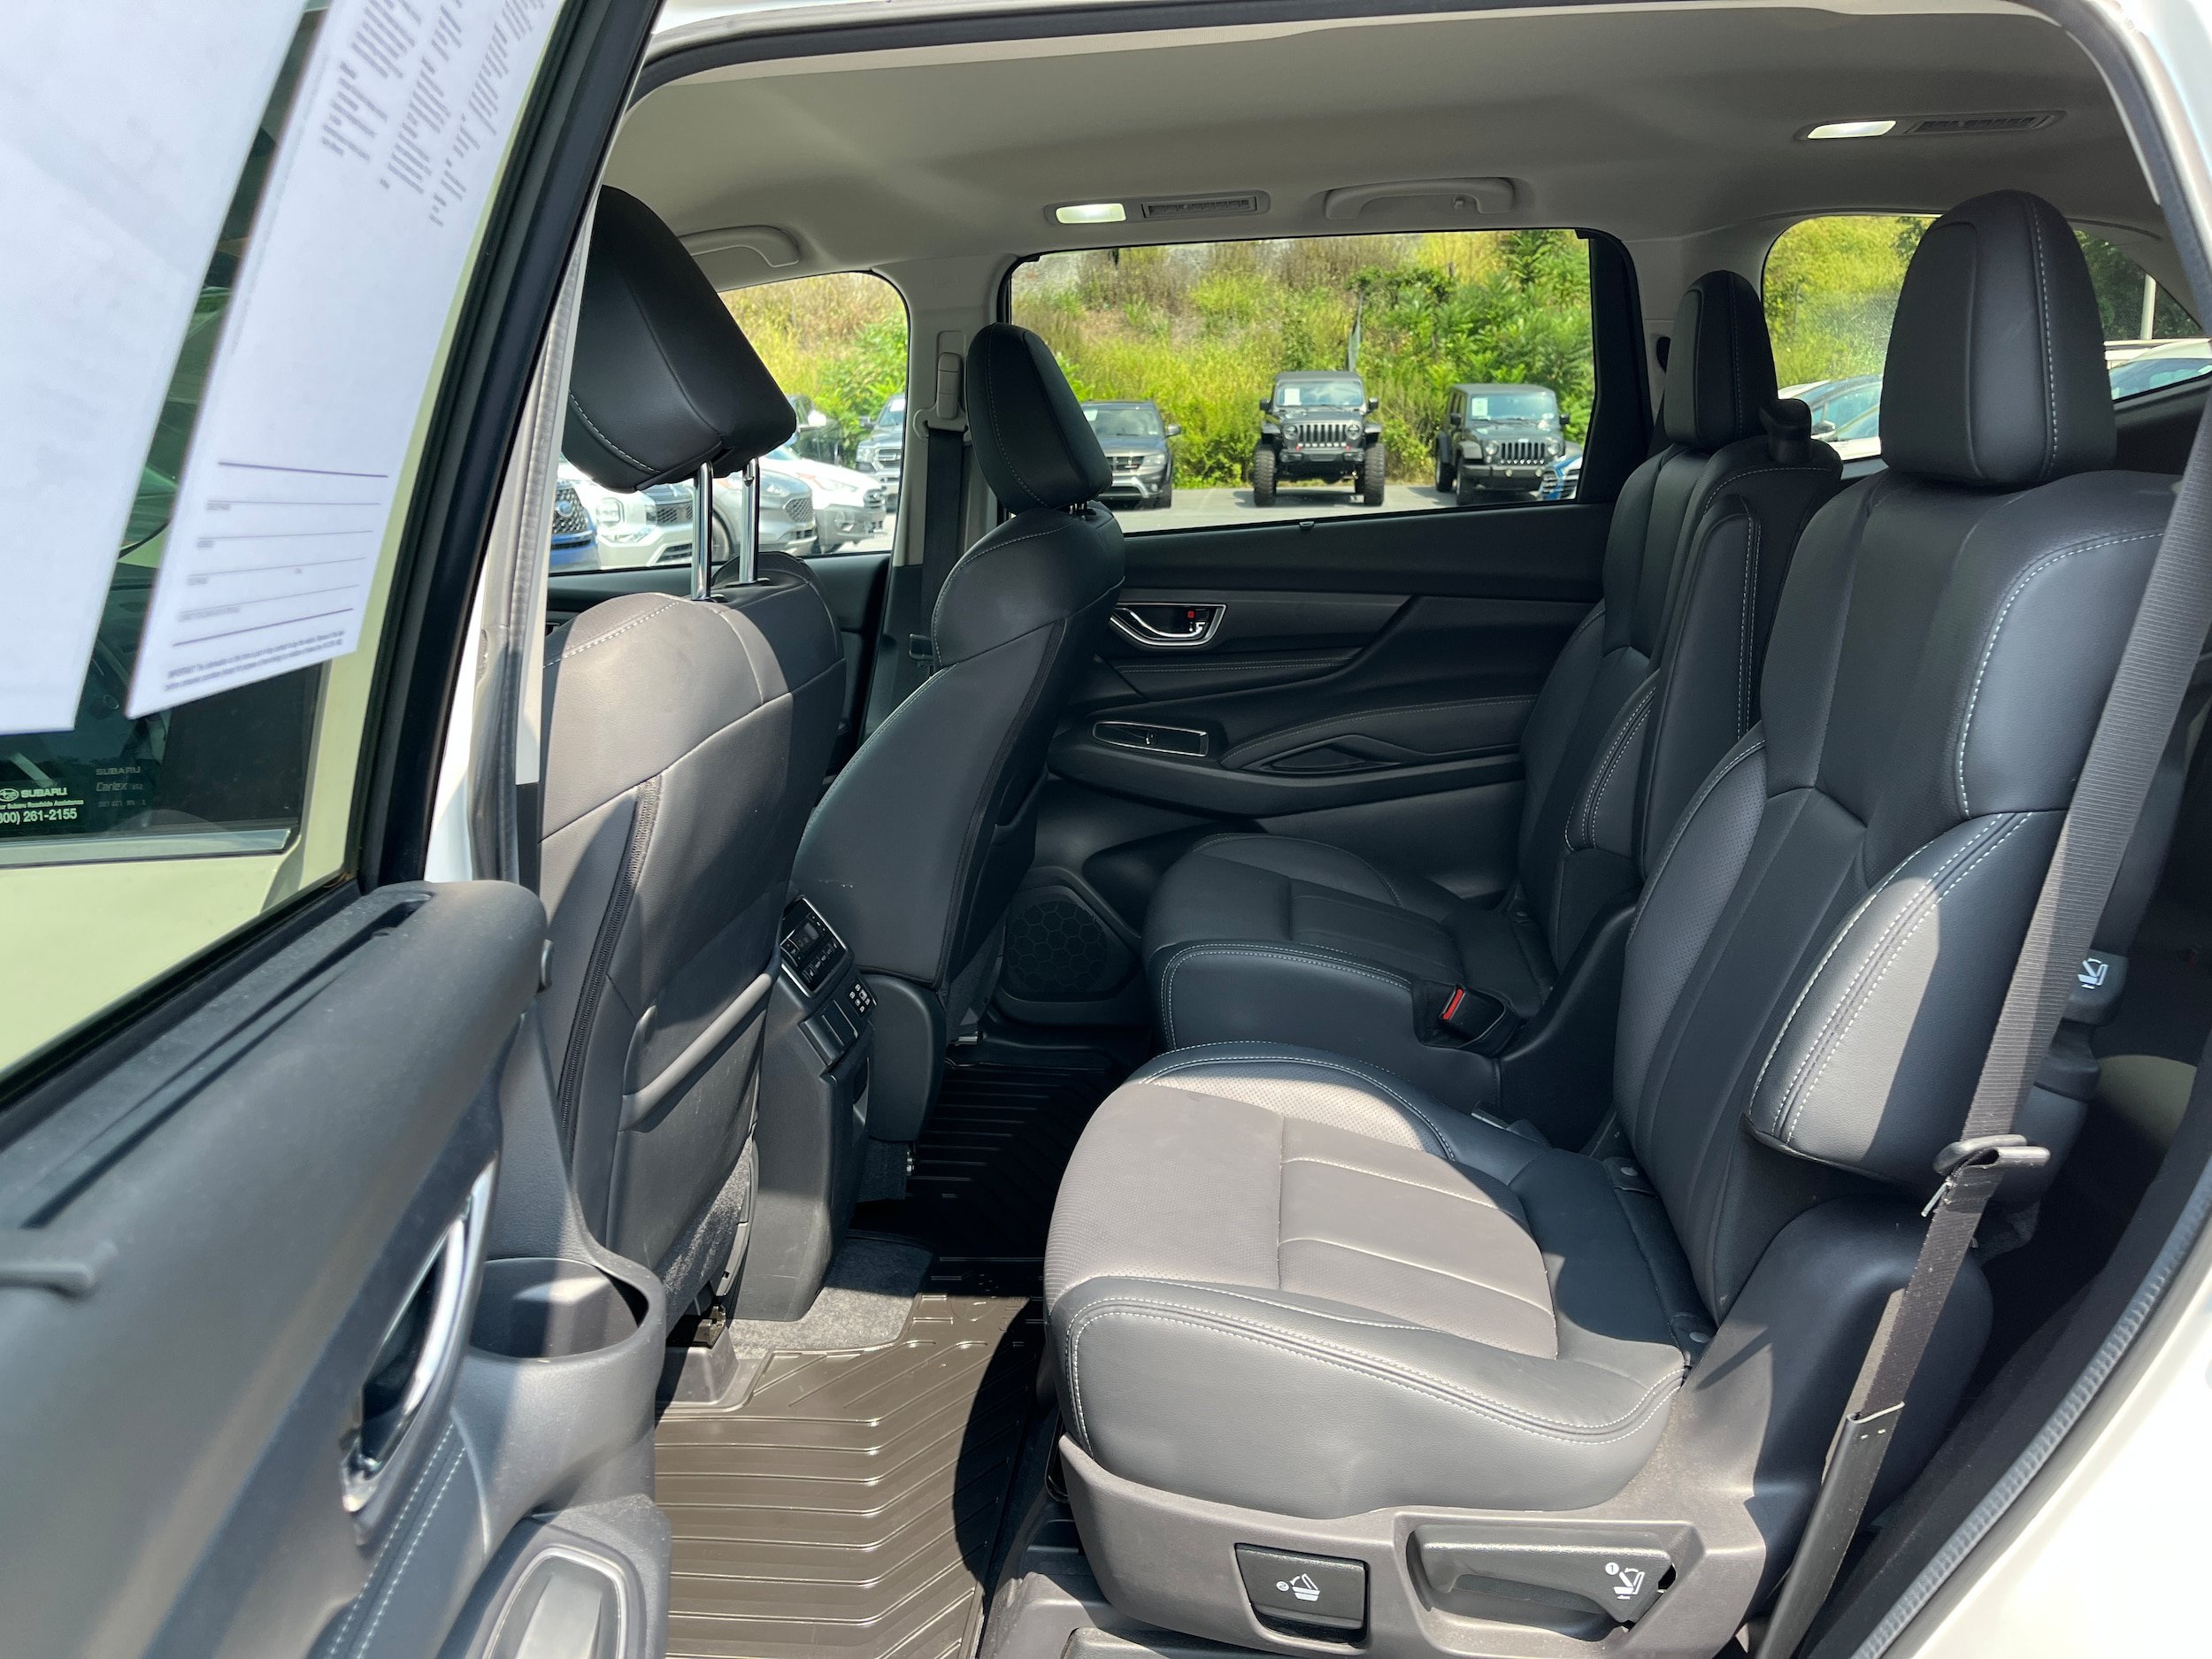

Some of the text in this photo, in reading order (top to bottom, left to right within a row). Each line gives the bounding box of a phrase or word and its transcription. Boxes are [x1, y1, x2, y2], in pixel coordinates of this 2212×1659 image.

[96, 766, 141, 776] SUBARU
[20, 787, 68, 798] SUBARU
[23, 807, 78, 823] 261-2155
